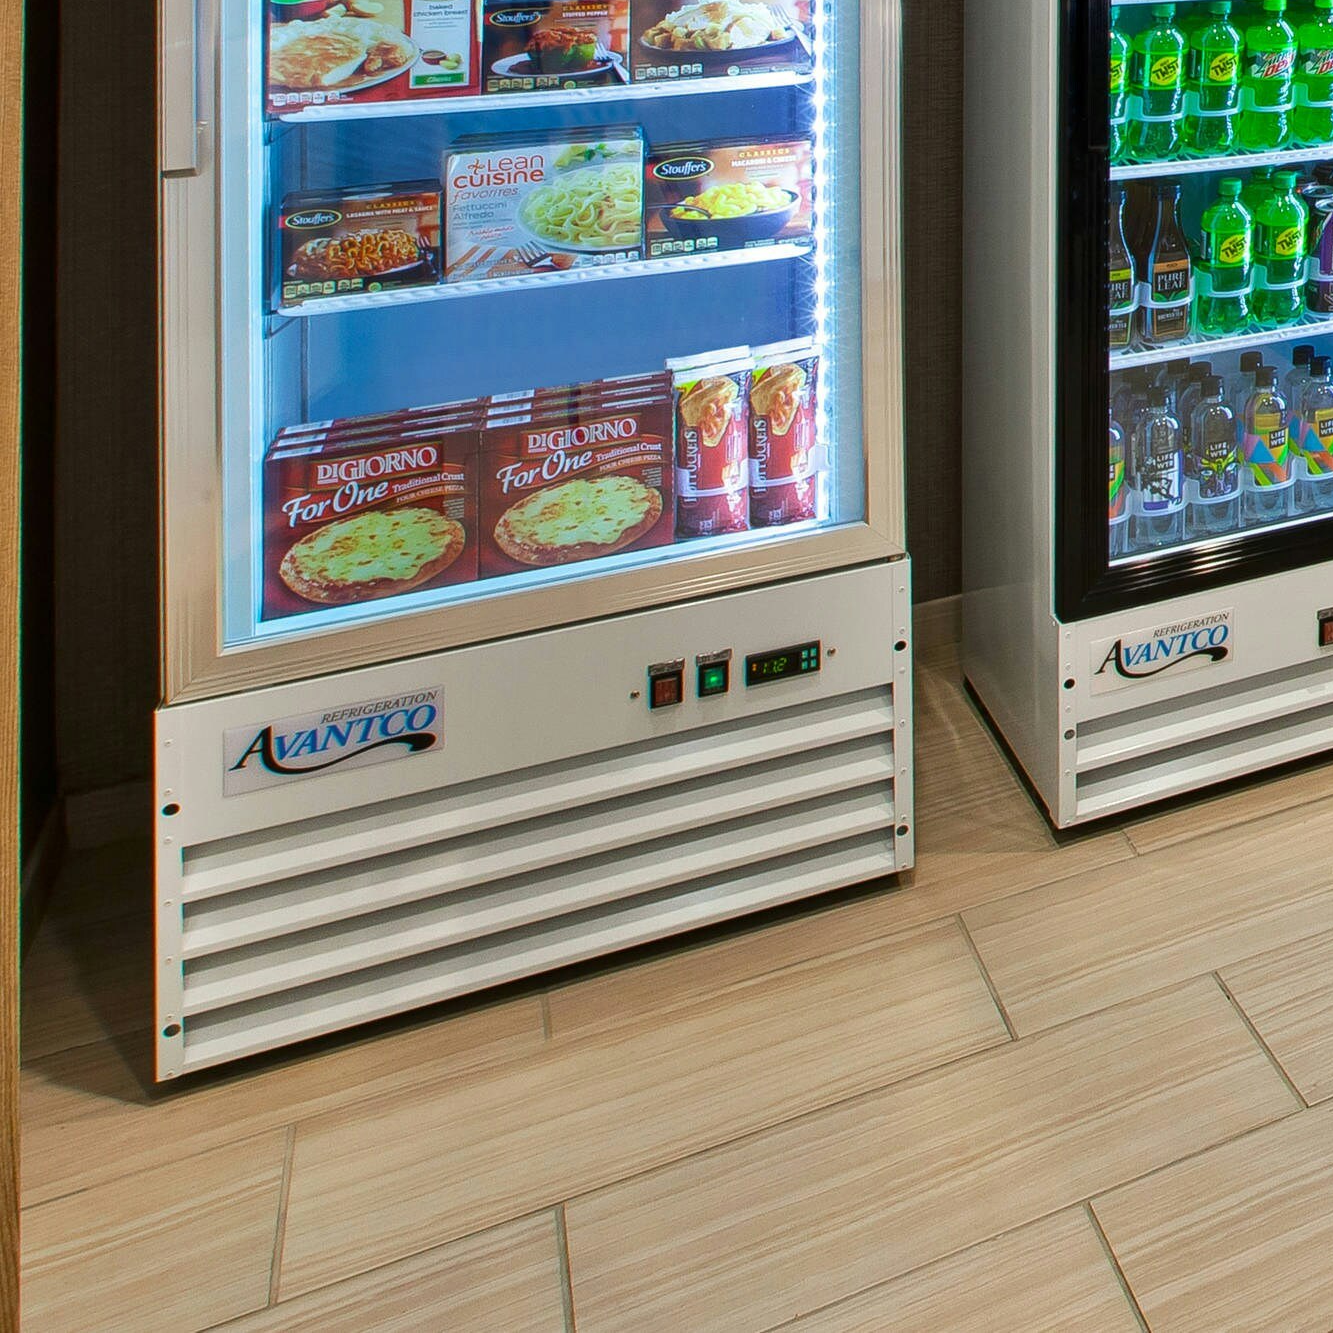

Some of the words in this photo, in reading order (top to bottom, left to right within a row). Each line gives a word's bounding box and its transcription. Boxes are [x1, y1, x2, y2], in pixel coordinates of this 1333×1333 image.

[497, 10, 536, 23] Stouffer's
[488, 153, 544, 173] Lean
[660, 160, 707, 177] Stouffer's
[453, 169, 545, 190] cuisine
[452, 188, 520, 204] favorites
[452, 202, 508, 213] Fettuccini
[291, 212, 335, 226] Stouffer's
[452, 211, 496, 221] Alfredo
[1157, 272, 1187, 282] PURE
[1157, 280, 1183, 291] LEAF
[1269, 430, 1286, 440] LIFE
[1209, 440, 1227, 450] LIFE
[1269, 437, 1286, 448] WTR
[595, 443, 640, 463] Traditional
[640, 442, 662, 451] Crust
[1157, 451, 1174, 461] LIFE
[1210, 449, 1227, 459] WTR
[496, 462, 541, 494] For
[541, 449, 593, 480] One
[1157, 460, 1174, 469] WTR
[392, 474, 441, 494] Traditional
[441, 472, 465, 482] Crust
[443, 483, 465, 492] PIZZA
[282, 494, 332, 528] For
[333, 480, 389, 514] One
[1152, 611, 1230, 639] REFRIGERATION
[1094, 623, 1228, 678] AVANTCO
[320, 690, 439, 725] REFRIGERATION
[228, 703, 438, 775] AVANTCO
